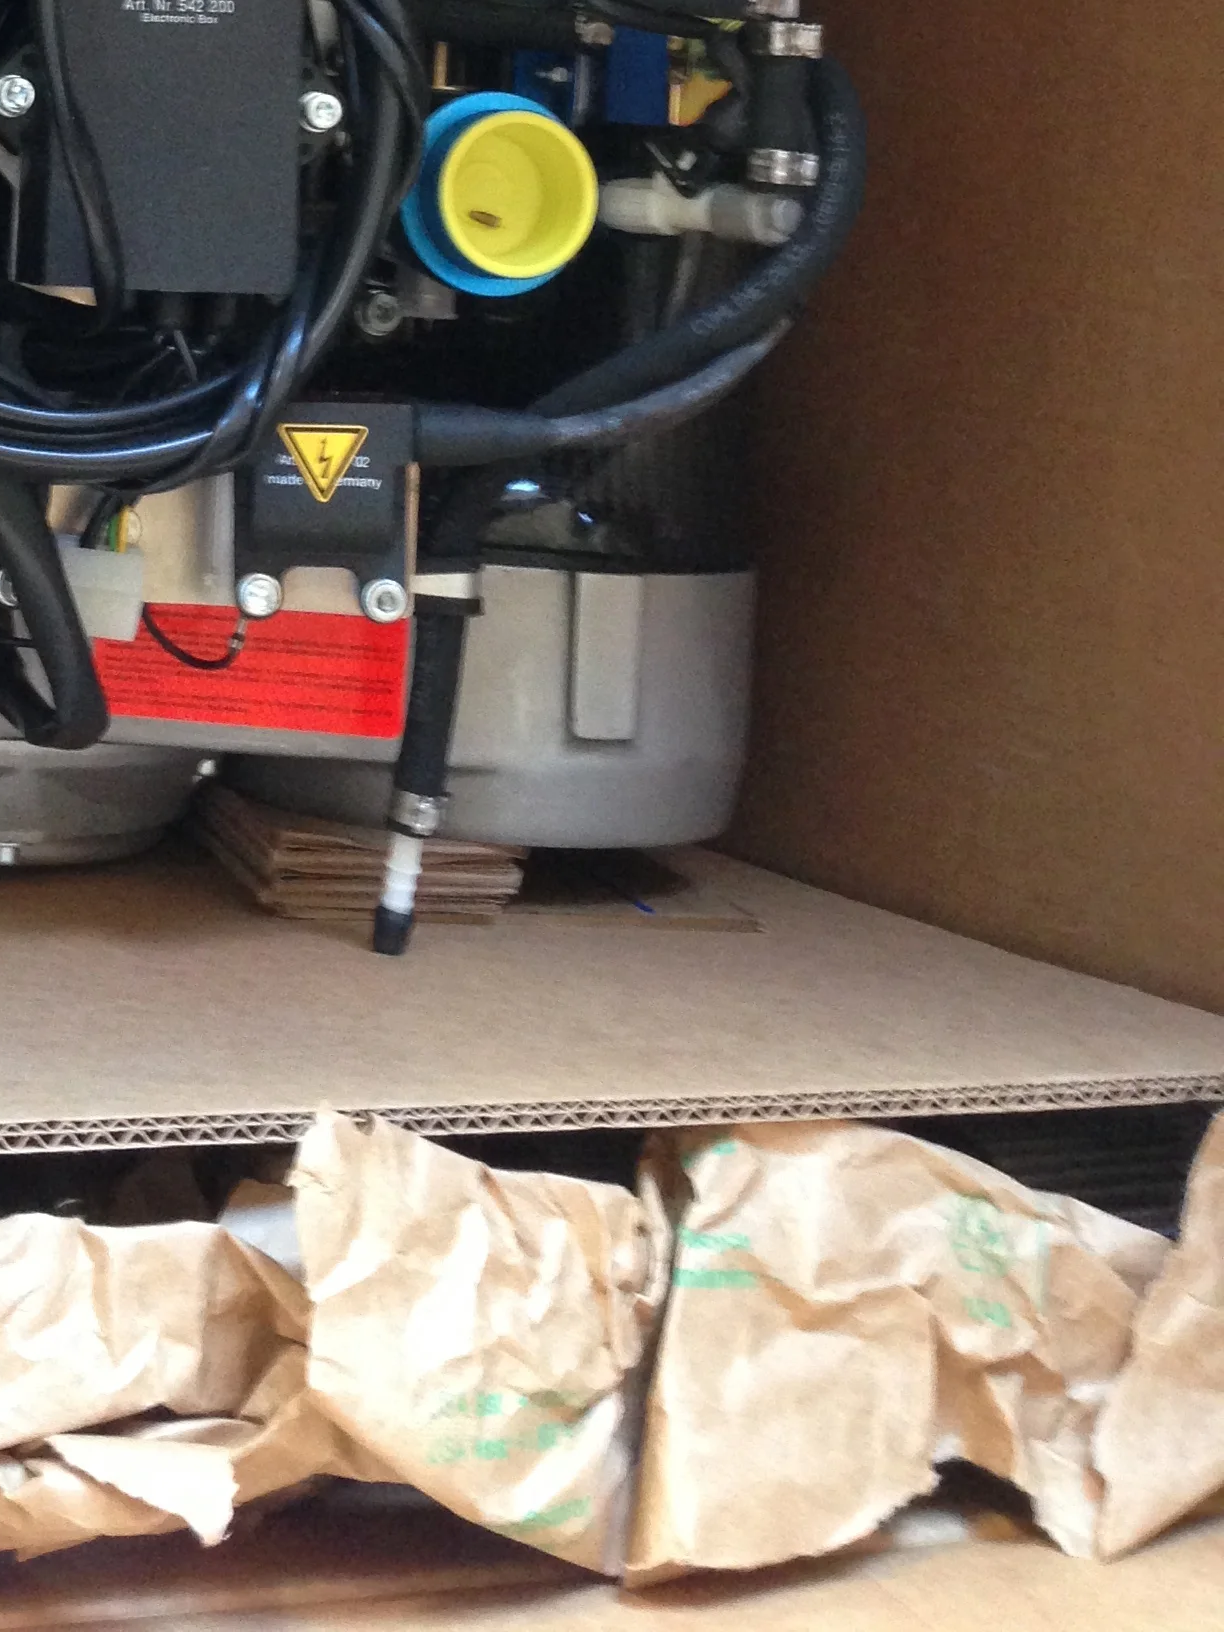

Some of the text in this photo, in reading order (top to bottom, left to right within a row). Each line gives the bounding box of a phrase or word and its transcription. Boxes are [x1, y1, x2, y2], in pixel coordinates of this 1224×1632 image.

[207, 0, 235, 13] 200
[140, 12, 196, 23] Electronic
[265, 474, 304, 486] made
